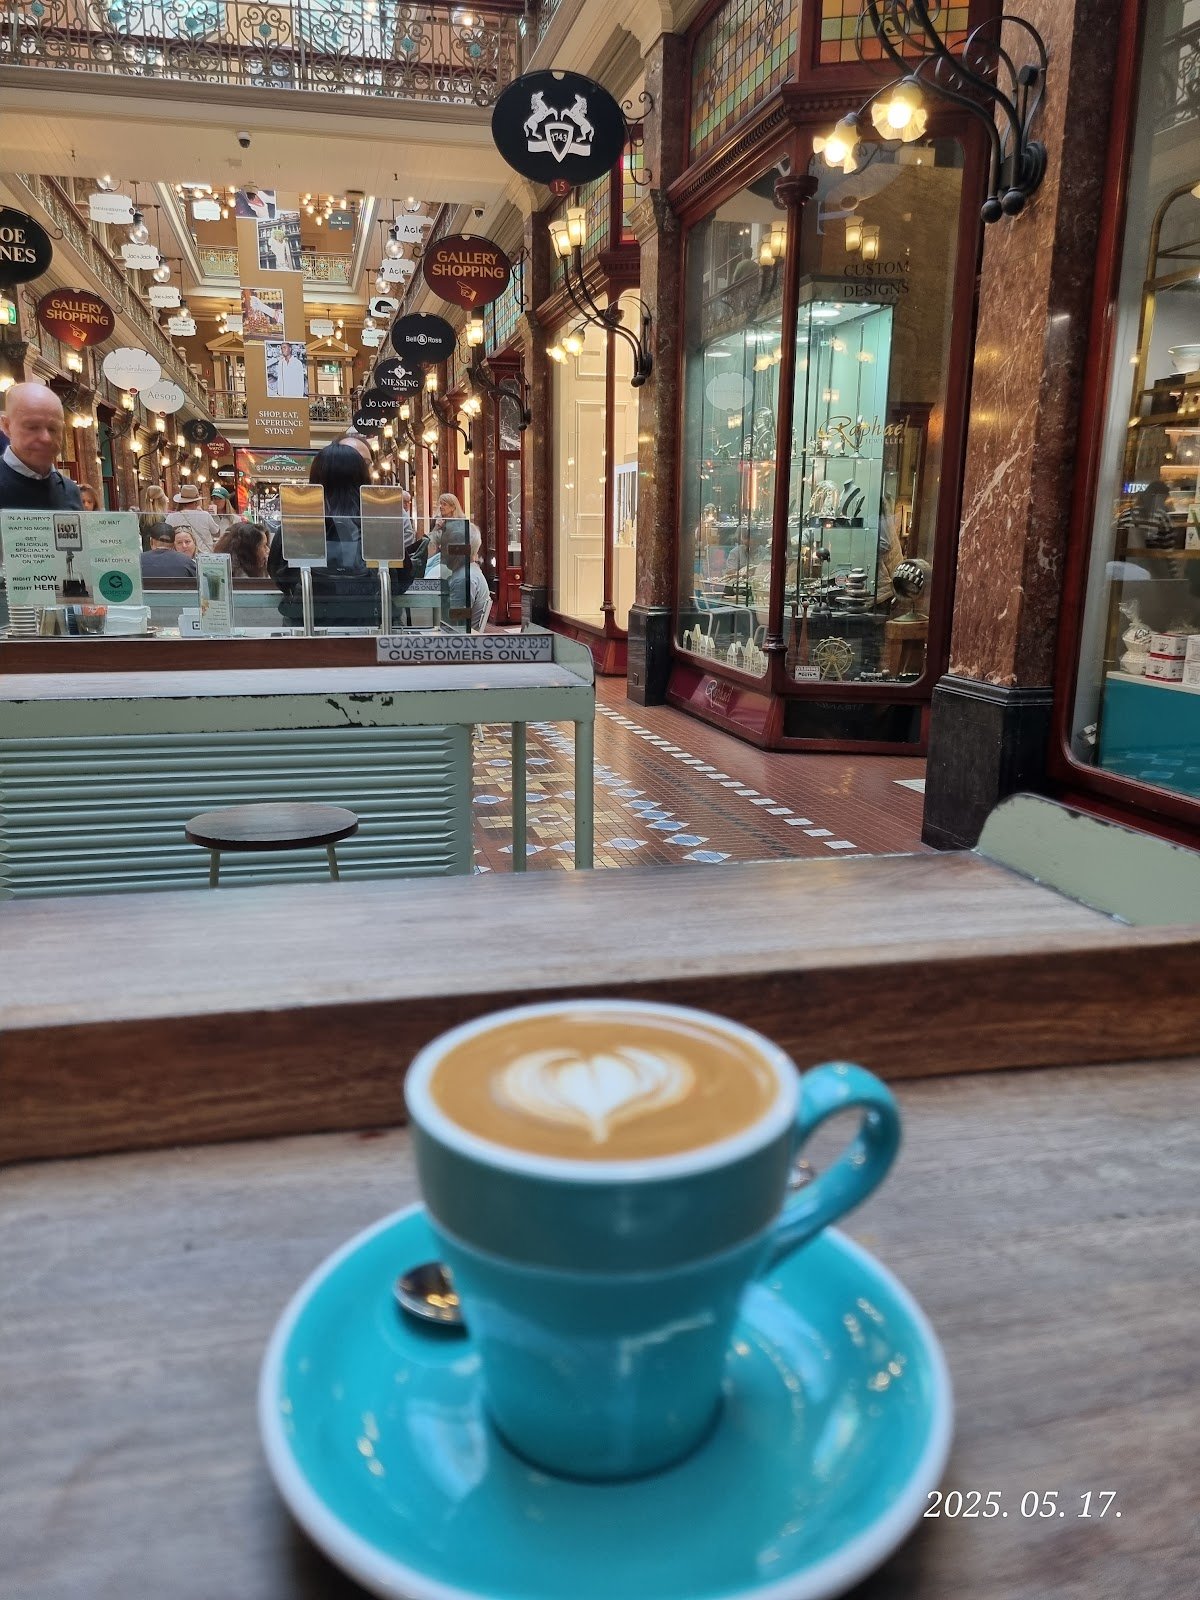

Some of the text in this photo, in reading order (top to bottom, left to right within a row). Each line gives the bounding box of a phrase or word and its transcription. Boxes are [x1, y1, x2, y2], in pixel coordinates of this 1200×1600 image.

[551, 133, 568, 143] 1743
[554, 181, 566, 192] 15
[404, 225, 423, 234] Acle
[437, 250, 498, 266] GALLERY
[432, 264, 505, 279] SHOPPING
[843, 261, 910, 278] CUSTOM
[843, 281, 910, 298] DESIGNS
[51, 299, 104, 315] GALLERY
[46, 309, 109, 326] SHOPPING
[381, 378, 419, 388] NIESSING
[378, 400, 400, 408] LOVES
[255, 419, 304, 428] EXPERIENCE
[264, 428, 295, 436] SYDNEY
[57, 523, 78, 533] HOT
[378, 636, 550, 650] GUMPTION COFFEE
[388, 650, 540, 661] CUSTOMERS ONLY
